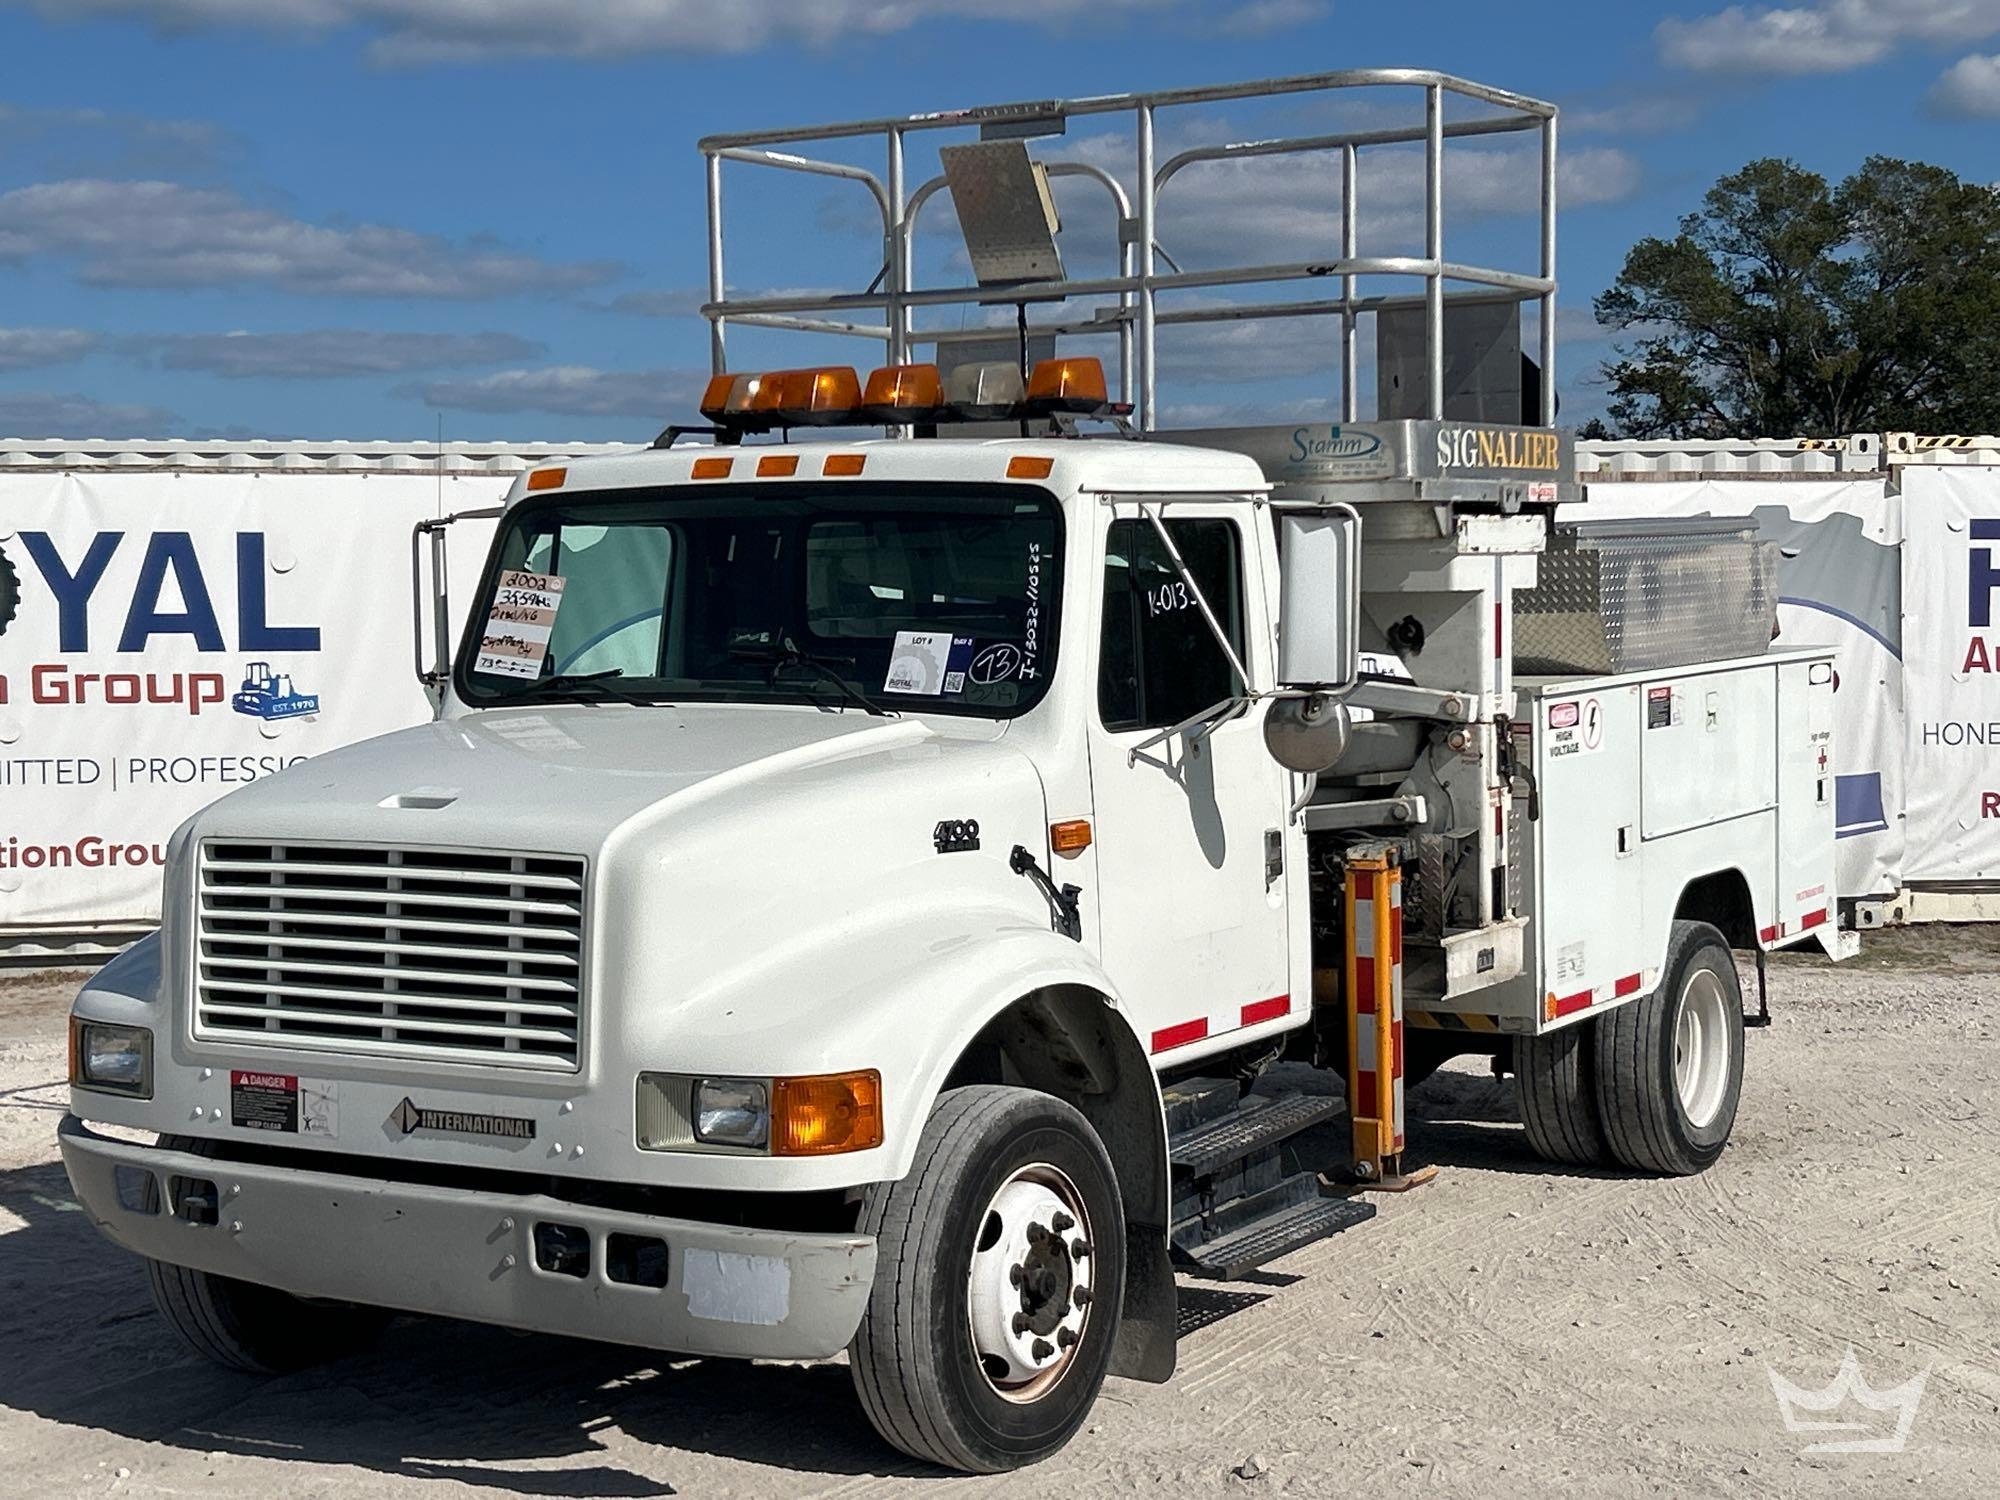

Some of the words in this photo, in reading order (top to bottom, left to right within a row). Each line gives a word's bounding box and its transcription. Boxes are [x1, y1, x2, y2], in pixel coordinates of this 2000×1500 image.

[1289, 427, 1361, 463] Stamm
[1437, 427, 1560, 470] SIGNALIER
[0, 531, 321, 653] YAL
[506, 572, 546, 591] 2002
[912, 636, 926, 645] LOT
[1962, 636, 2000, 674] A
[32, 664, 225, 715] Group
[272, 702, 290, 713] EST.
[291, 699, 315, 710] 1970
[0, 758, 101, 785] ITTED
[249, 1075, 286, 1088] DANGER
[421, 1110, 532, 1138] INTERNATIONAL
